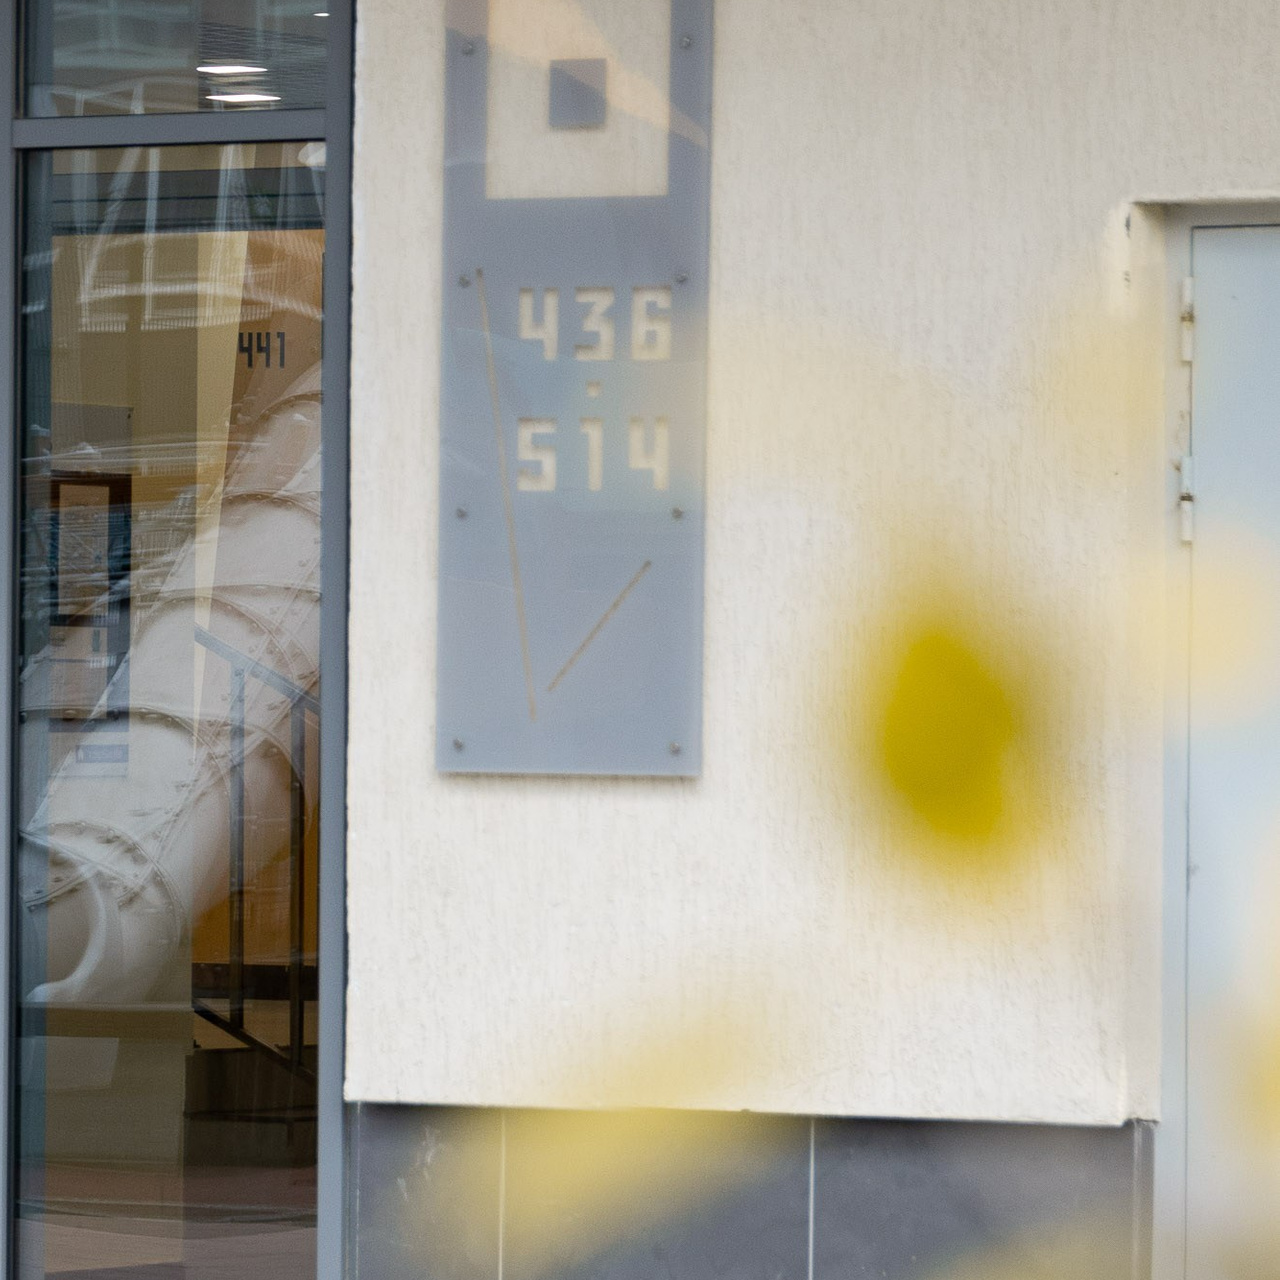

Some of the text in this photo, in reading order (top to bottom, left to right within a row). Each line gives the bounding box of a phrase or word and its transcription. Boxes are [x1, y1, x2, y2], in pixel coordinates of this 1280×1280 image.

[238, 332, 285, 368] 441
[519, 286, 671, 361] 436
[517, 416, 669, 491] 514
